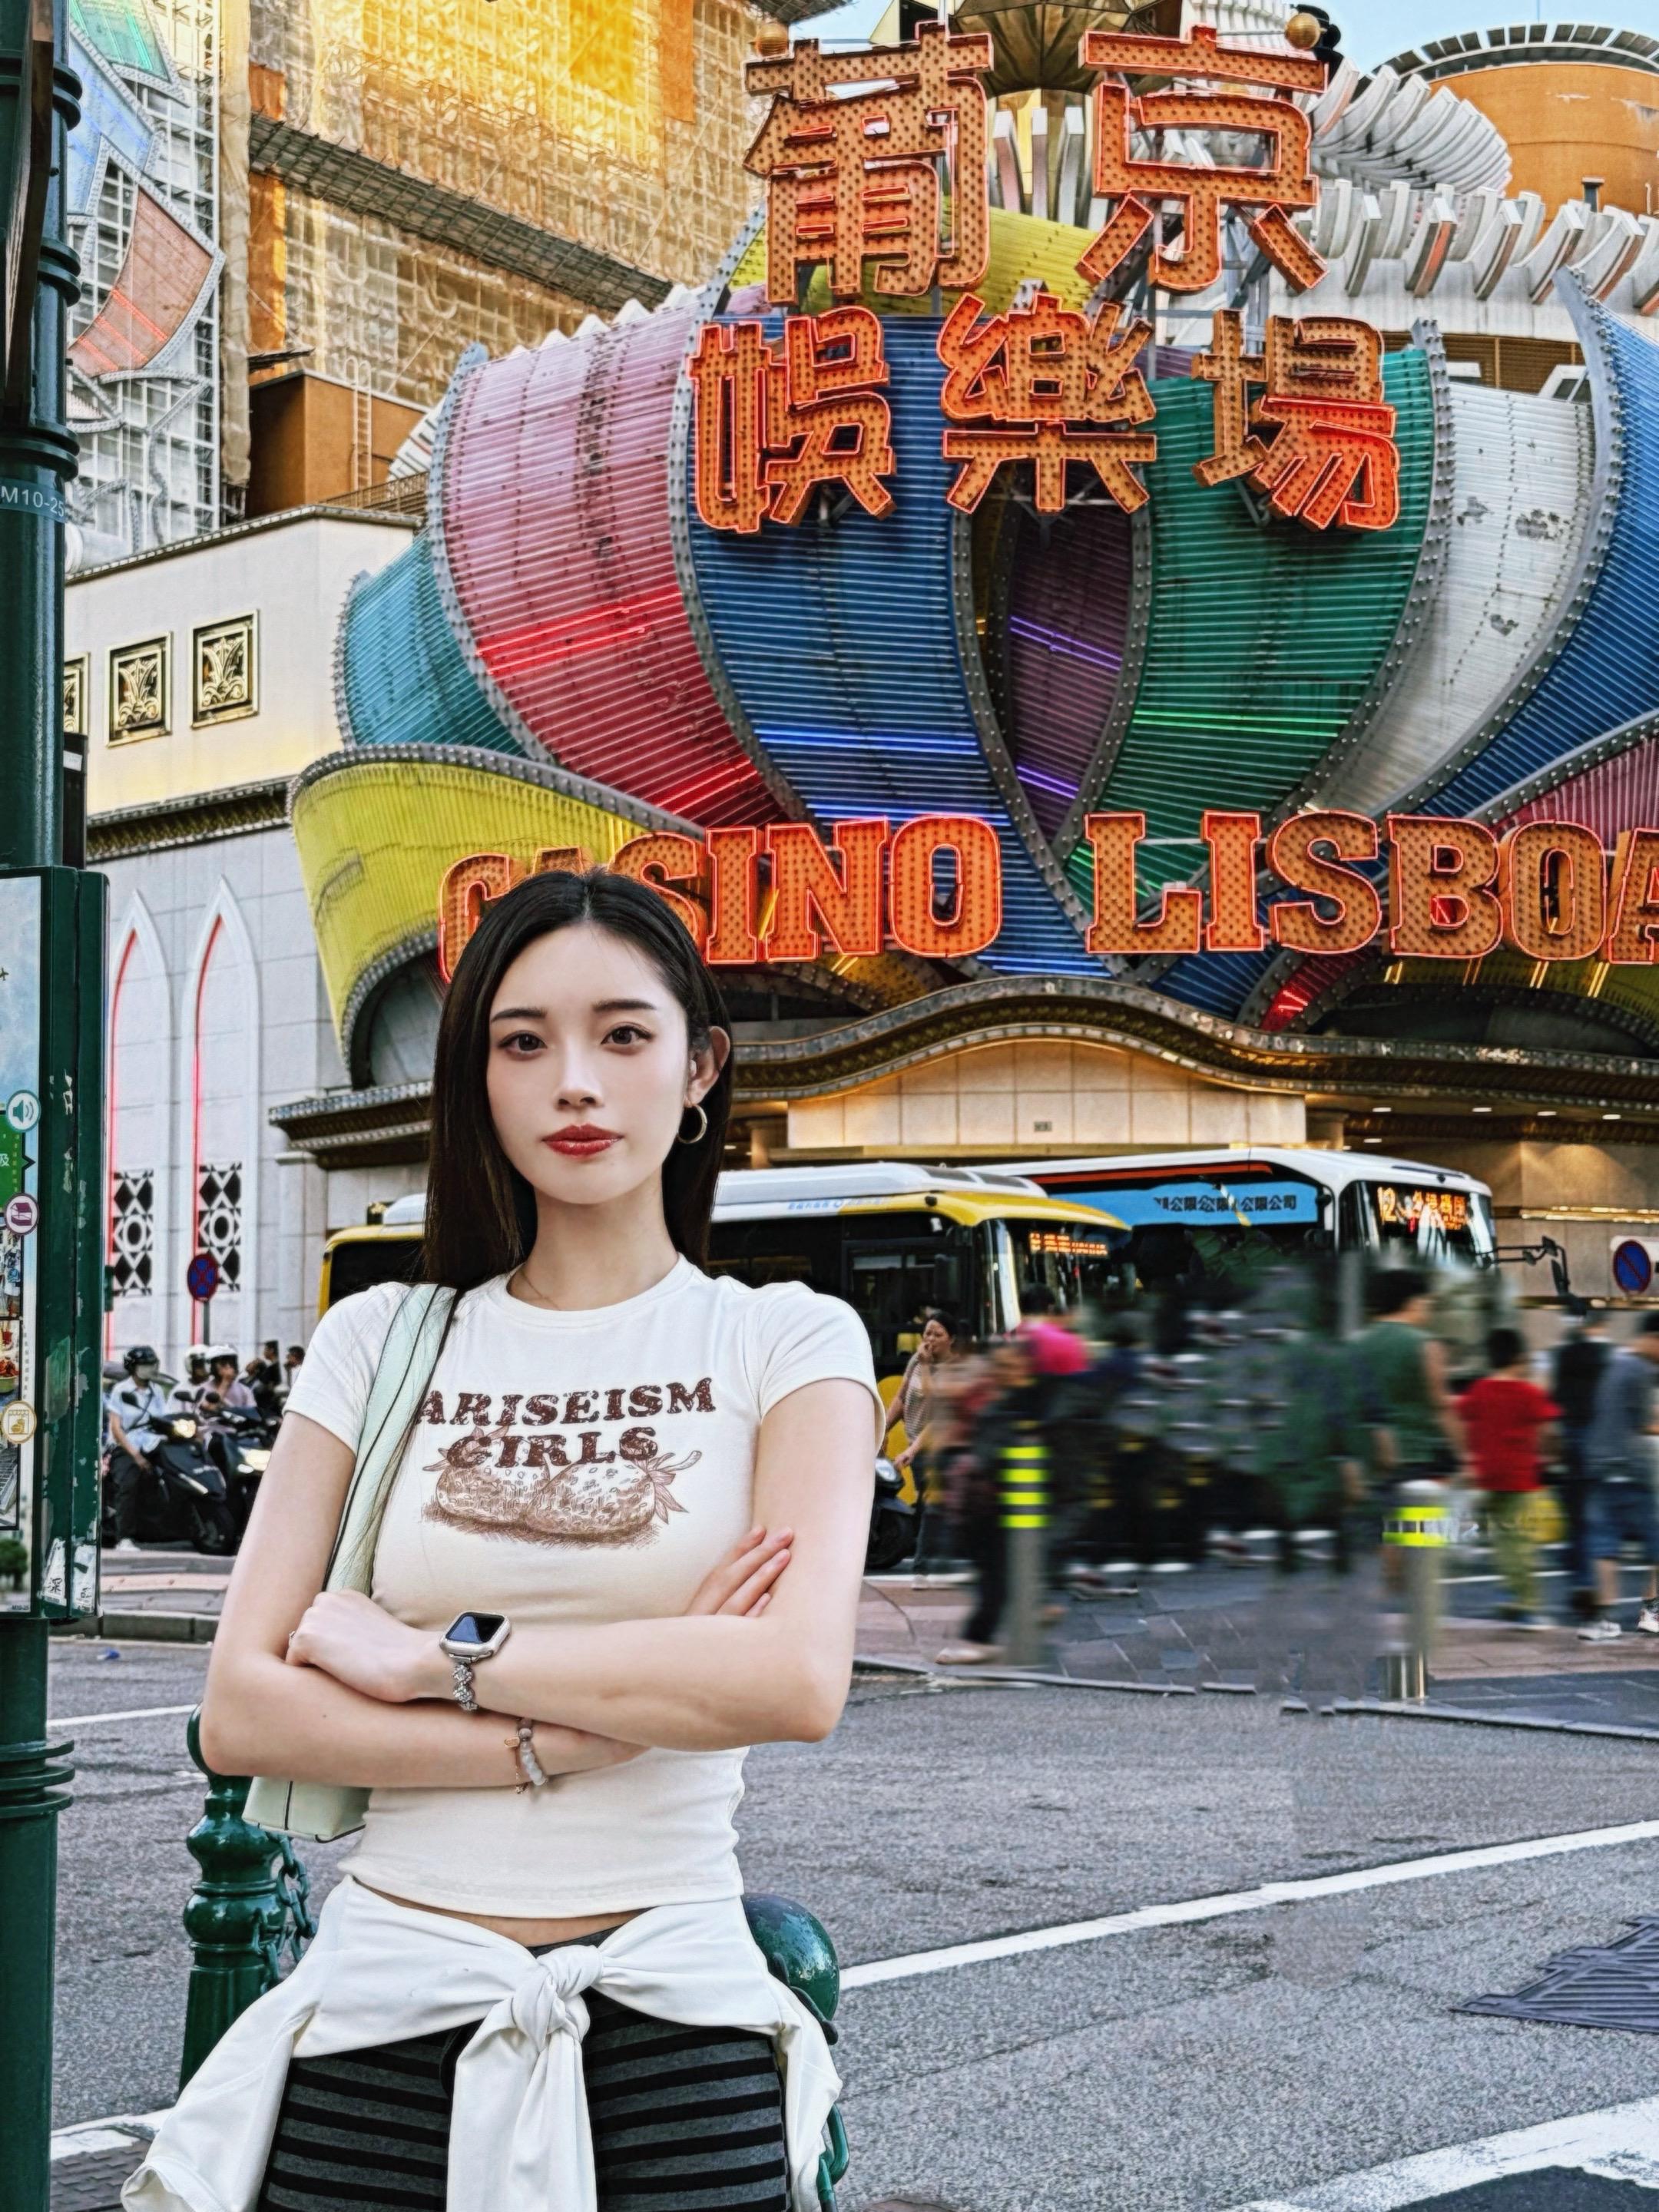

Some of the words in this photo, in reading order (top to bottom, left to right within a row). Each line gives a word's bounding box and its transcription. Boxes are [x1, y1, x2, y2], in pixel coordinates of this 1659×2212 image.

[743, 21, 1329, 304] 葡京
[1, 485, 65, 518] M10-25
[414, 1377, 717, 1426] ARISEISM
